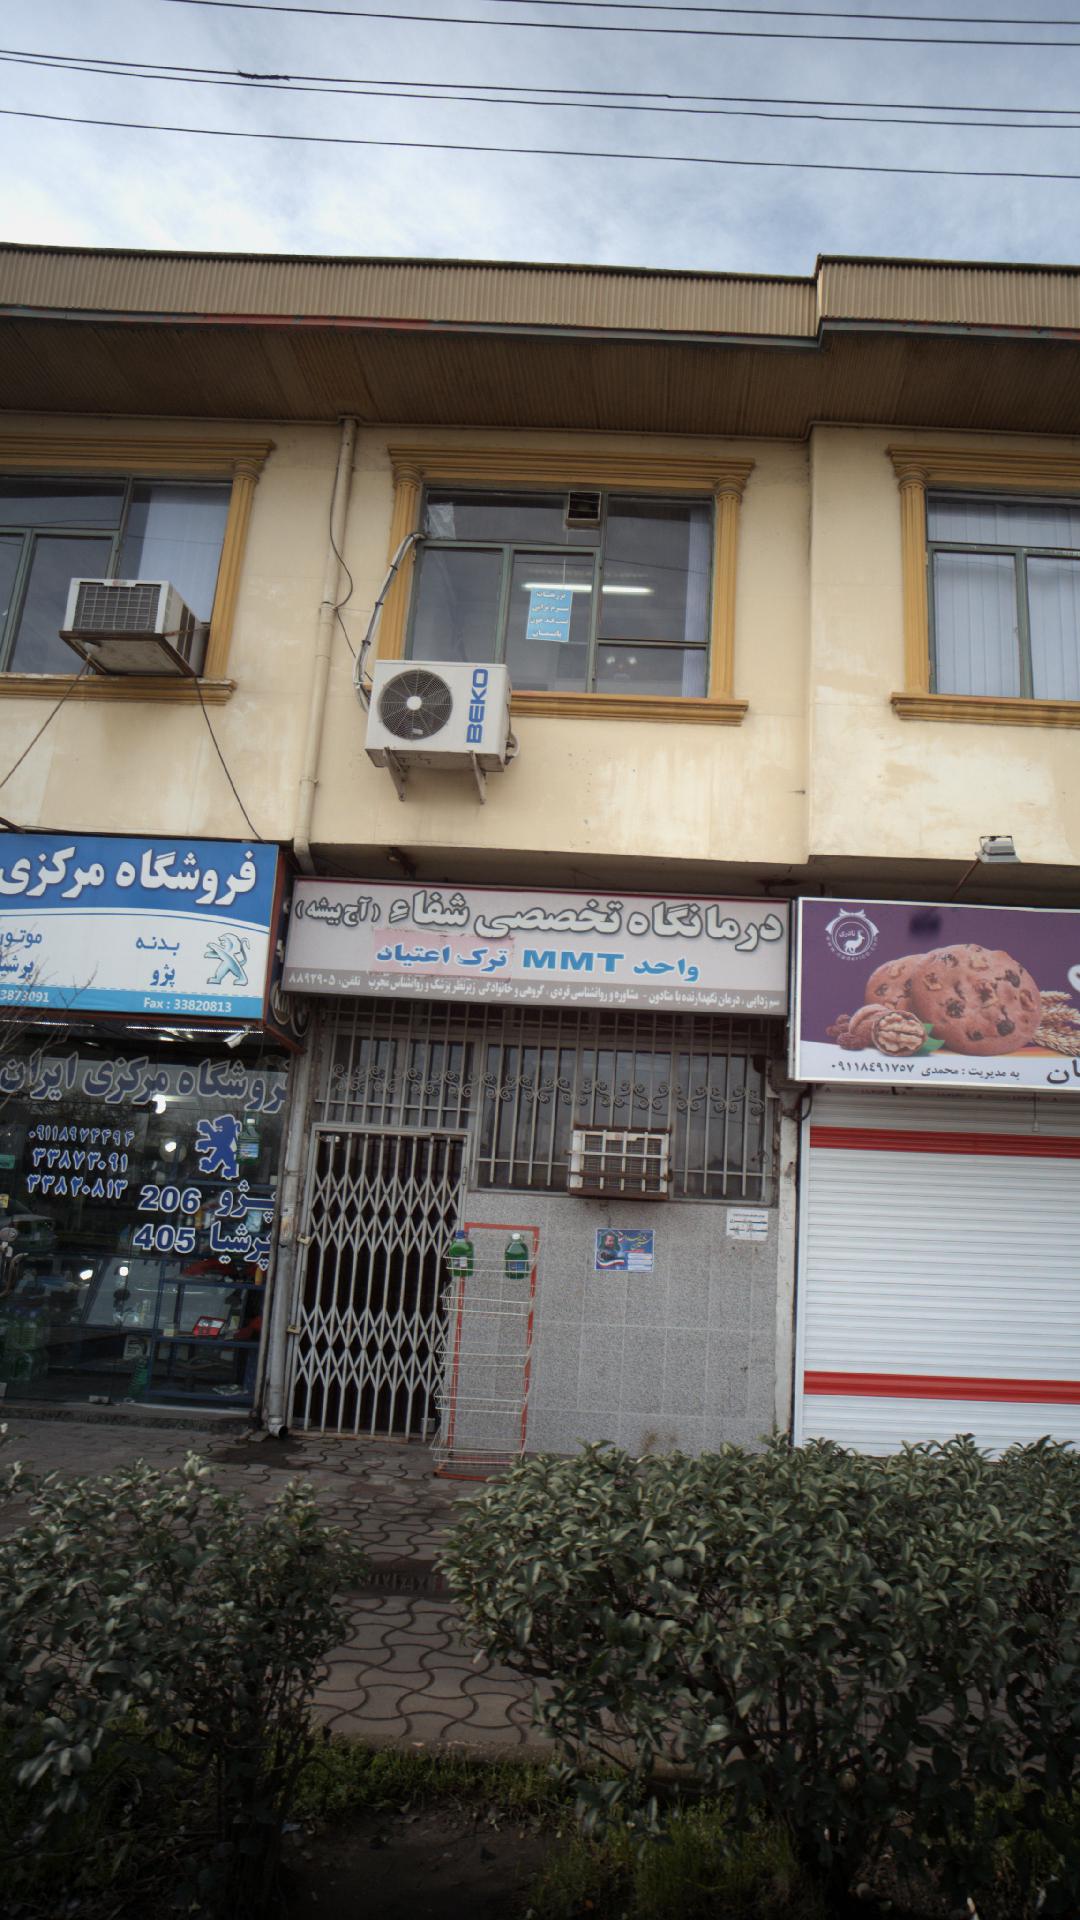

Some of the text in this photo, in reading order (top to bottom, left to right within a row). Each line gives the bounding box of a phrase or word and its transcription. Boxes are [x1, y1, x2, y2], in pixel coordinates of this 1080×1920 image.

[466, 668, 488, 744] BEKO
[0, 846, 257, 906] فروشگاه مرکزی
[389, 889, 471, 927] شفاء
[474, 898, 623, 939] تخصصی
[627, 901, 783, 952] درمانگاه
[136, 936, 180, 956] بدنه
[376, 943, 508, 972] ترک اعتیاد
[522, 949, 624, 973] MMT
[150, 964, 176, 987] پژو
[633, 957, 701, 982] واحد
[143, 997, 164, 1009] Fax
[174, 998, 232, 1013] 33820813
[0, 1050, 79, 1100] ایران
[82, 1056, 169, 1105] مرکزی
[921, 1065, 959, 1077] محمدی
[968, 1067, 1007, 1080] مدیریت
[138, 1184, 201, 1214] 206
[132, 1223, 196, 1253] 405
